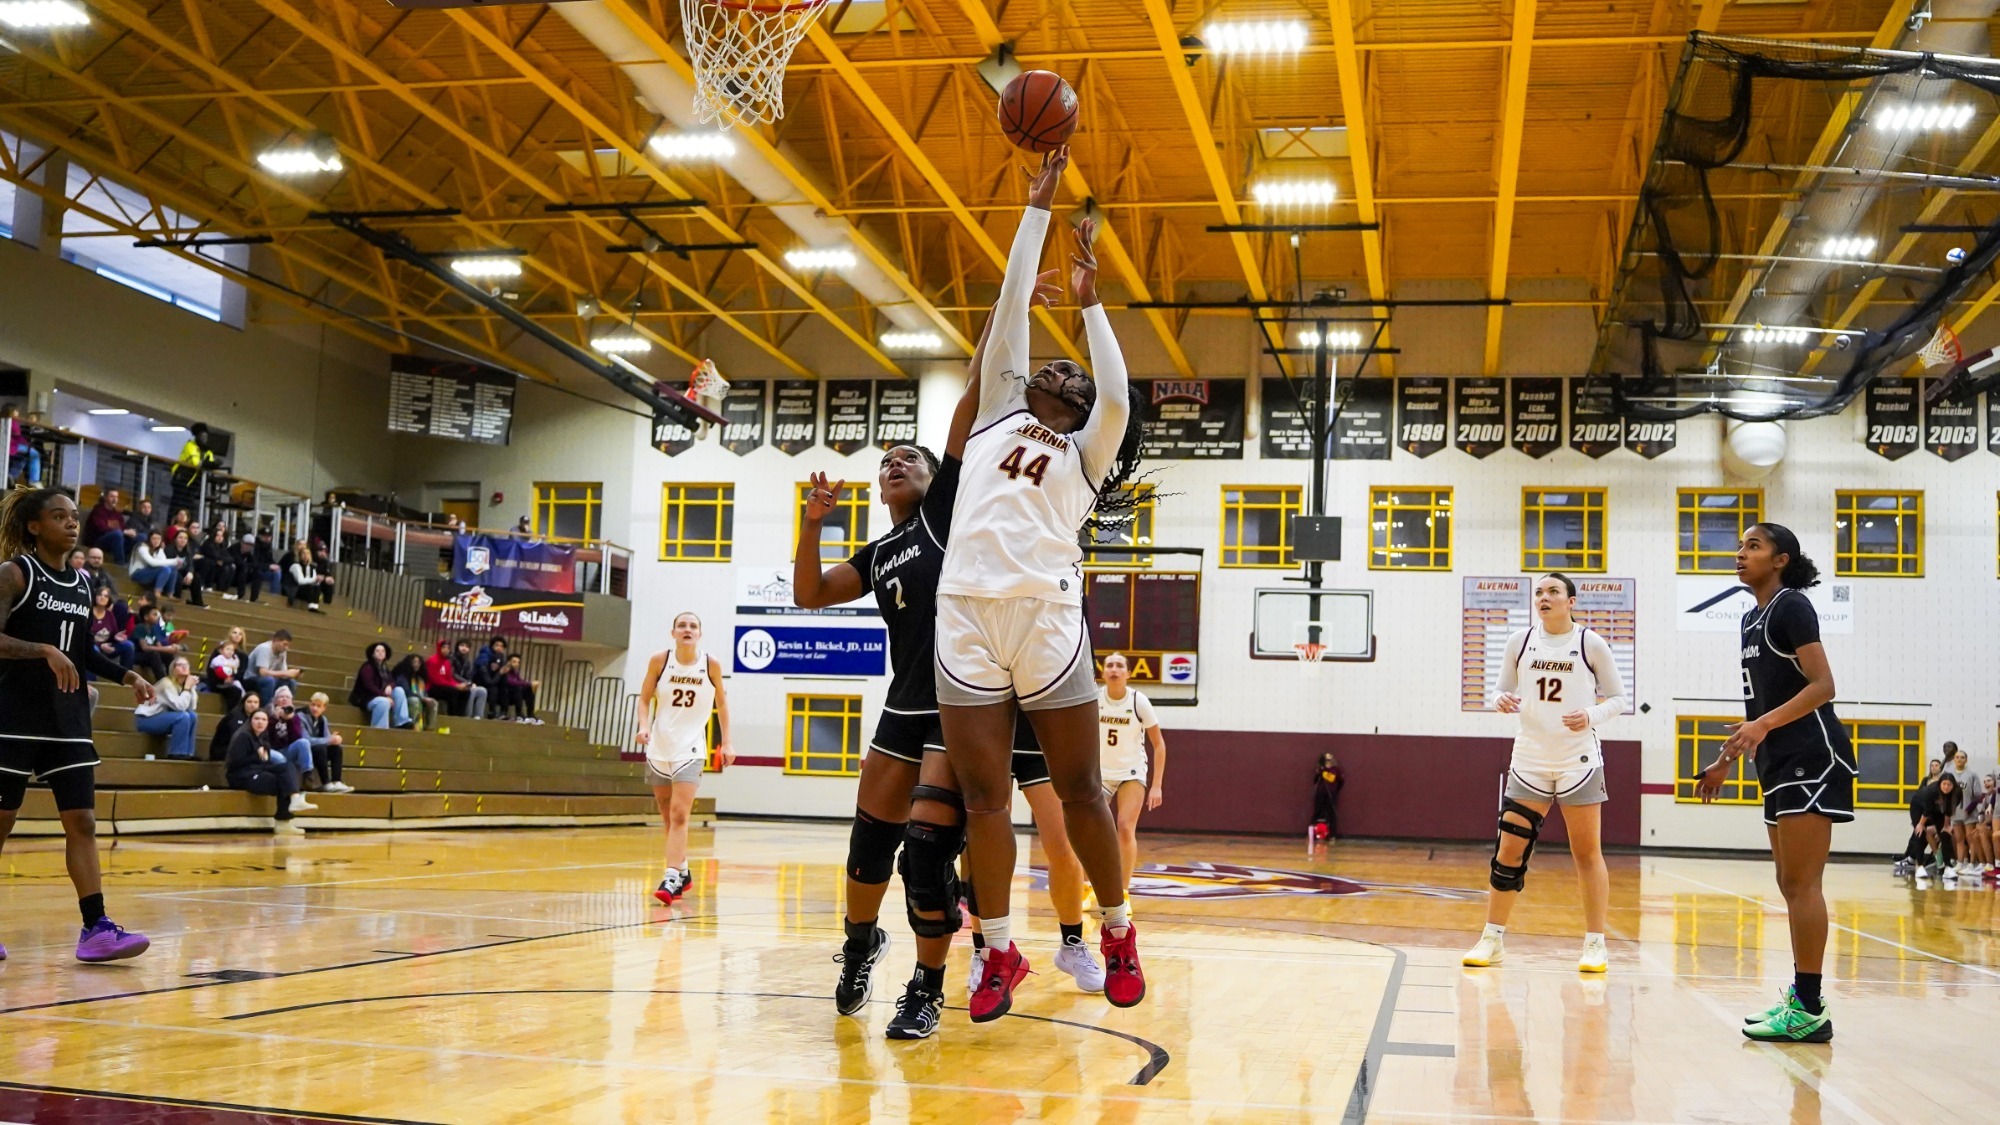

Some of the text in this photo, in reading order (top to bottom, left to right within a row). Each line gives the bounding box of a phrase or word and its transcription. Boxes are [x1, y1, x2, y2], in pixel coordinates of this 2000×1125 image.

[1155, 383, 1205, 399] NAIA
[1405, 387, 1442, 395] CHAMPIONS
[1462, 387, 1499, 395] CHAMPIONS
[1519, 392, 1555, 401] Baseball
[1406, 402, 1439, 410] Baseball
[1460, 406, 1499, 414] Basketball
[1876, 402, 1910, 411] Baseball
[1931, 407, 1972, 415] Basketball
[723, 424, 761, 440] 1994
[775, 424, 814, 440] 1994
[828, 424, 867, 440] 1995
[877, 424, 917, 440] 1995
[1402, 424, 1445, 441] 1998
[1457, 424, 1504, 441] 2000
[1514, 424, 1557, 441] 2001
[1573, 424, 1620, 441] 2002
[1628, 424, 1675, 441] 2002
[1869, 425, 1918, 443] 2003
[1928, 426, 1977, 444] 2003
[998, 445, 1052, 488] 44
[1096, 575, 1126, 583] HOME
[1477, 582, 1519, 591] ALVERNIA
[1580, 583, 1623, 592] ALVERNIA
[1817, 613, 1848, 621] ROUP
[60, 620, 75, 652] 11
[744, 641, 770, 658] KB
[777, 641, 883, 653] Kevin L. Bickel, JD, LLM
[776, 652, 804, 660] Attorney
[1530, 660, 1573, 674] ALVERNIA
[670, 675, 703, 685] ALVERNIA
[1536, 677, 1562, 702] 12
[672, 689, 696, 708] 23
[1100, 715, 1130, 725] ALVERNIA
[1107, 729, 1118, 746] 5
